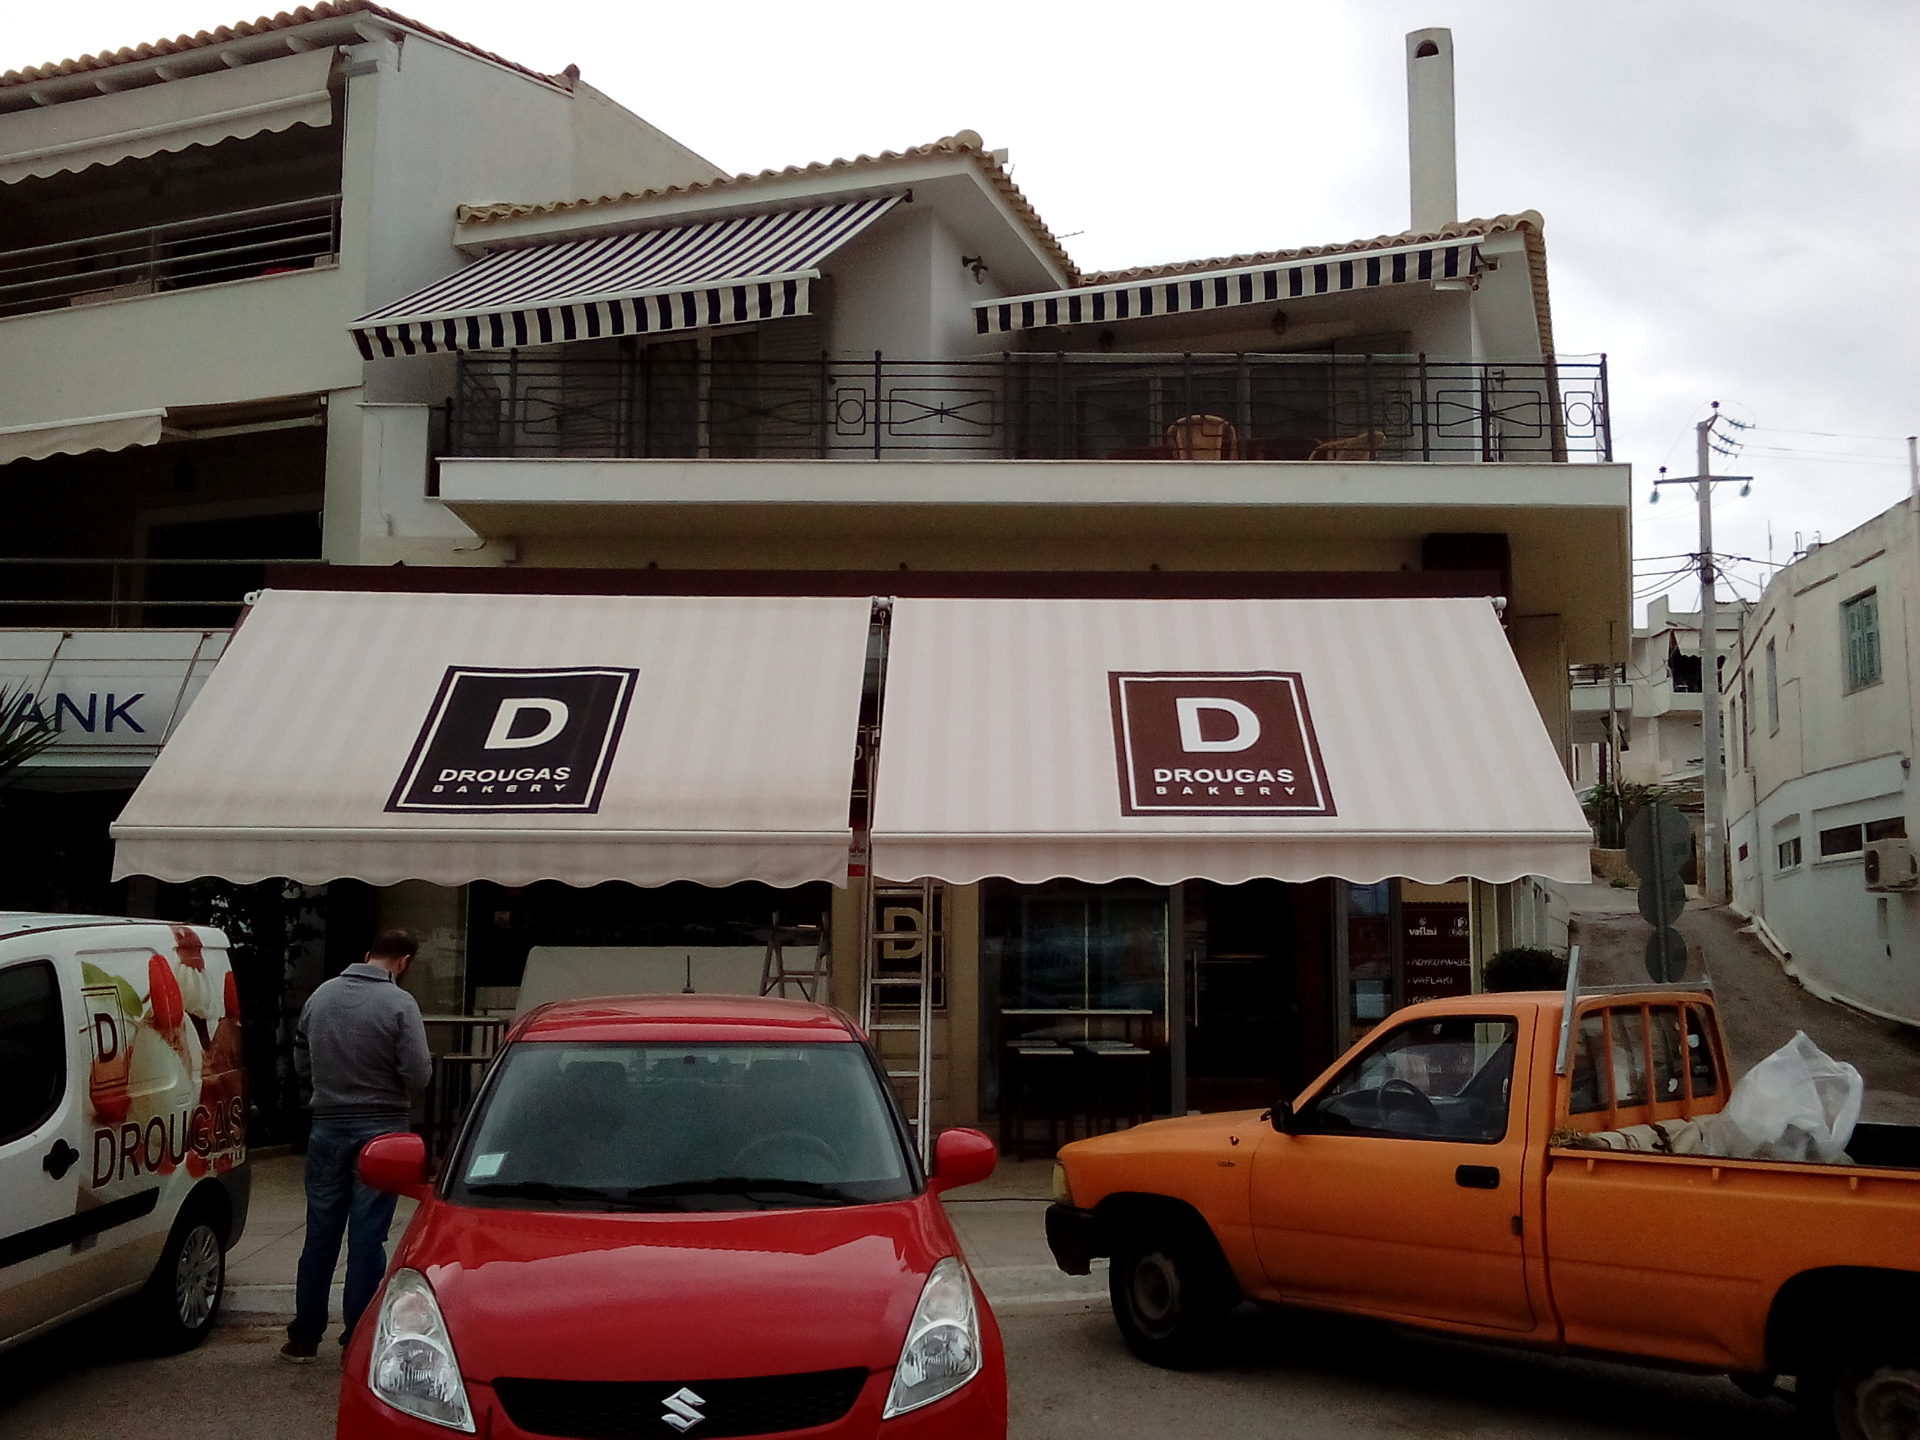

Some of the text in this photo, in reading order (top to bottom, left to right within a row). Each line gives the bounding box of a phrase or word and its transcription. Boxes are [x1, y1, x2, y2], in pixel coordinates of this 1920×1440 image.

[0, 693, 146, 734] ANK
[484, 697, 569, 750] D
[1176, 697, 1261, 753] D
[432, 783, 567, 794] BAKERY
[438, 766, 571, 783] DROUGAS
[1153, 768, 1295, 783] DROUGAS
[1155, 785, 1297, 796] BAKERY
[883, 906, 924, 959] D
[1412, 976, 1453, 986] VAFLAKI
[94, 1012, 118, 1064] D
[92, 1095, 244, 1189] DROUGAS
